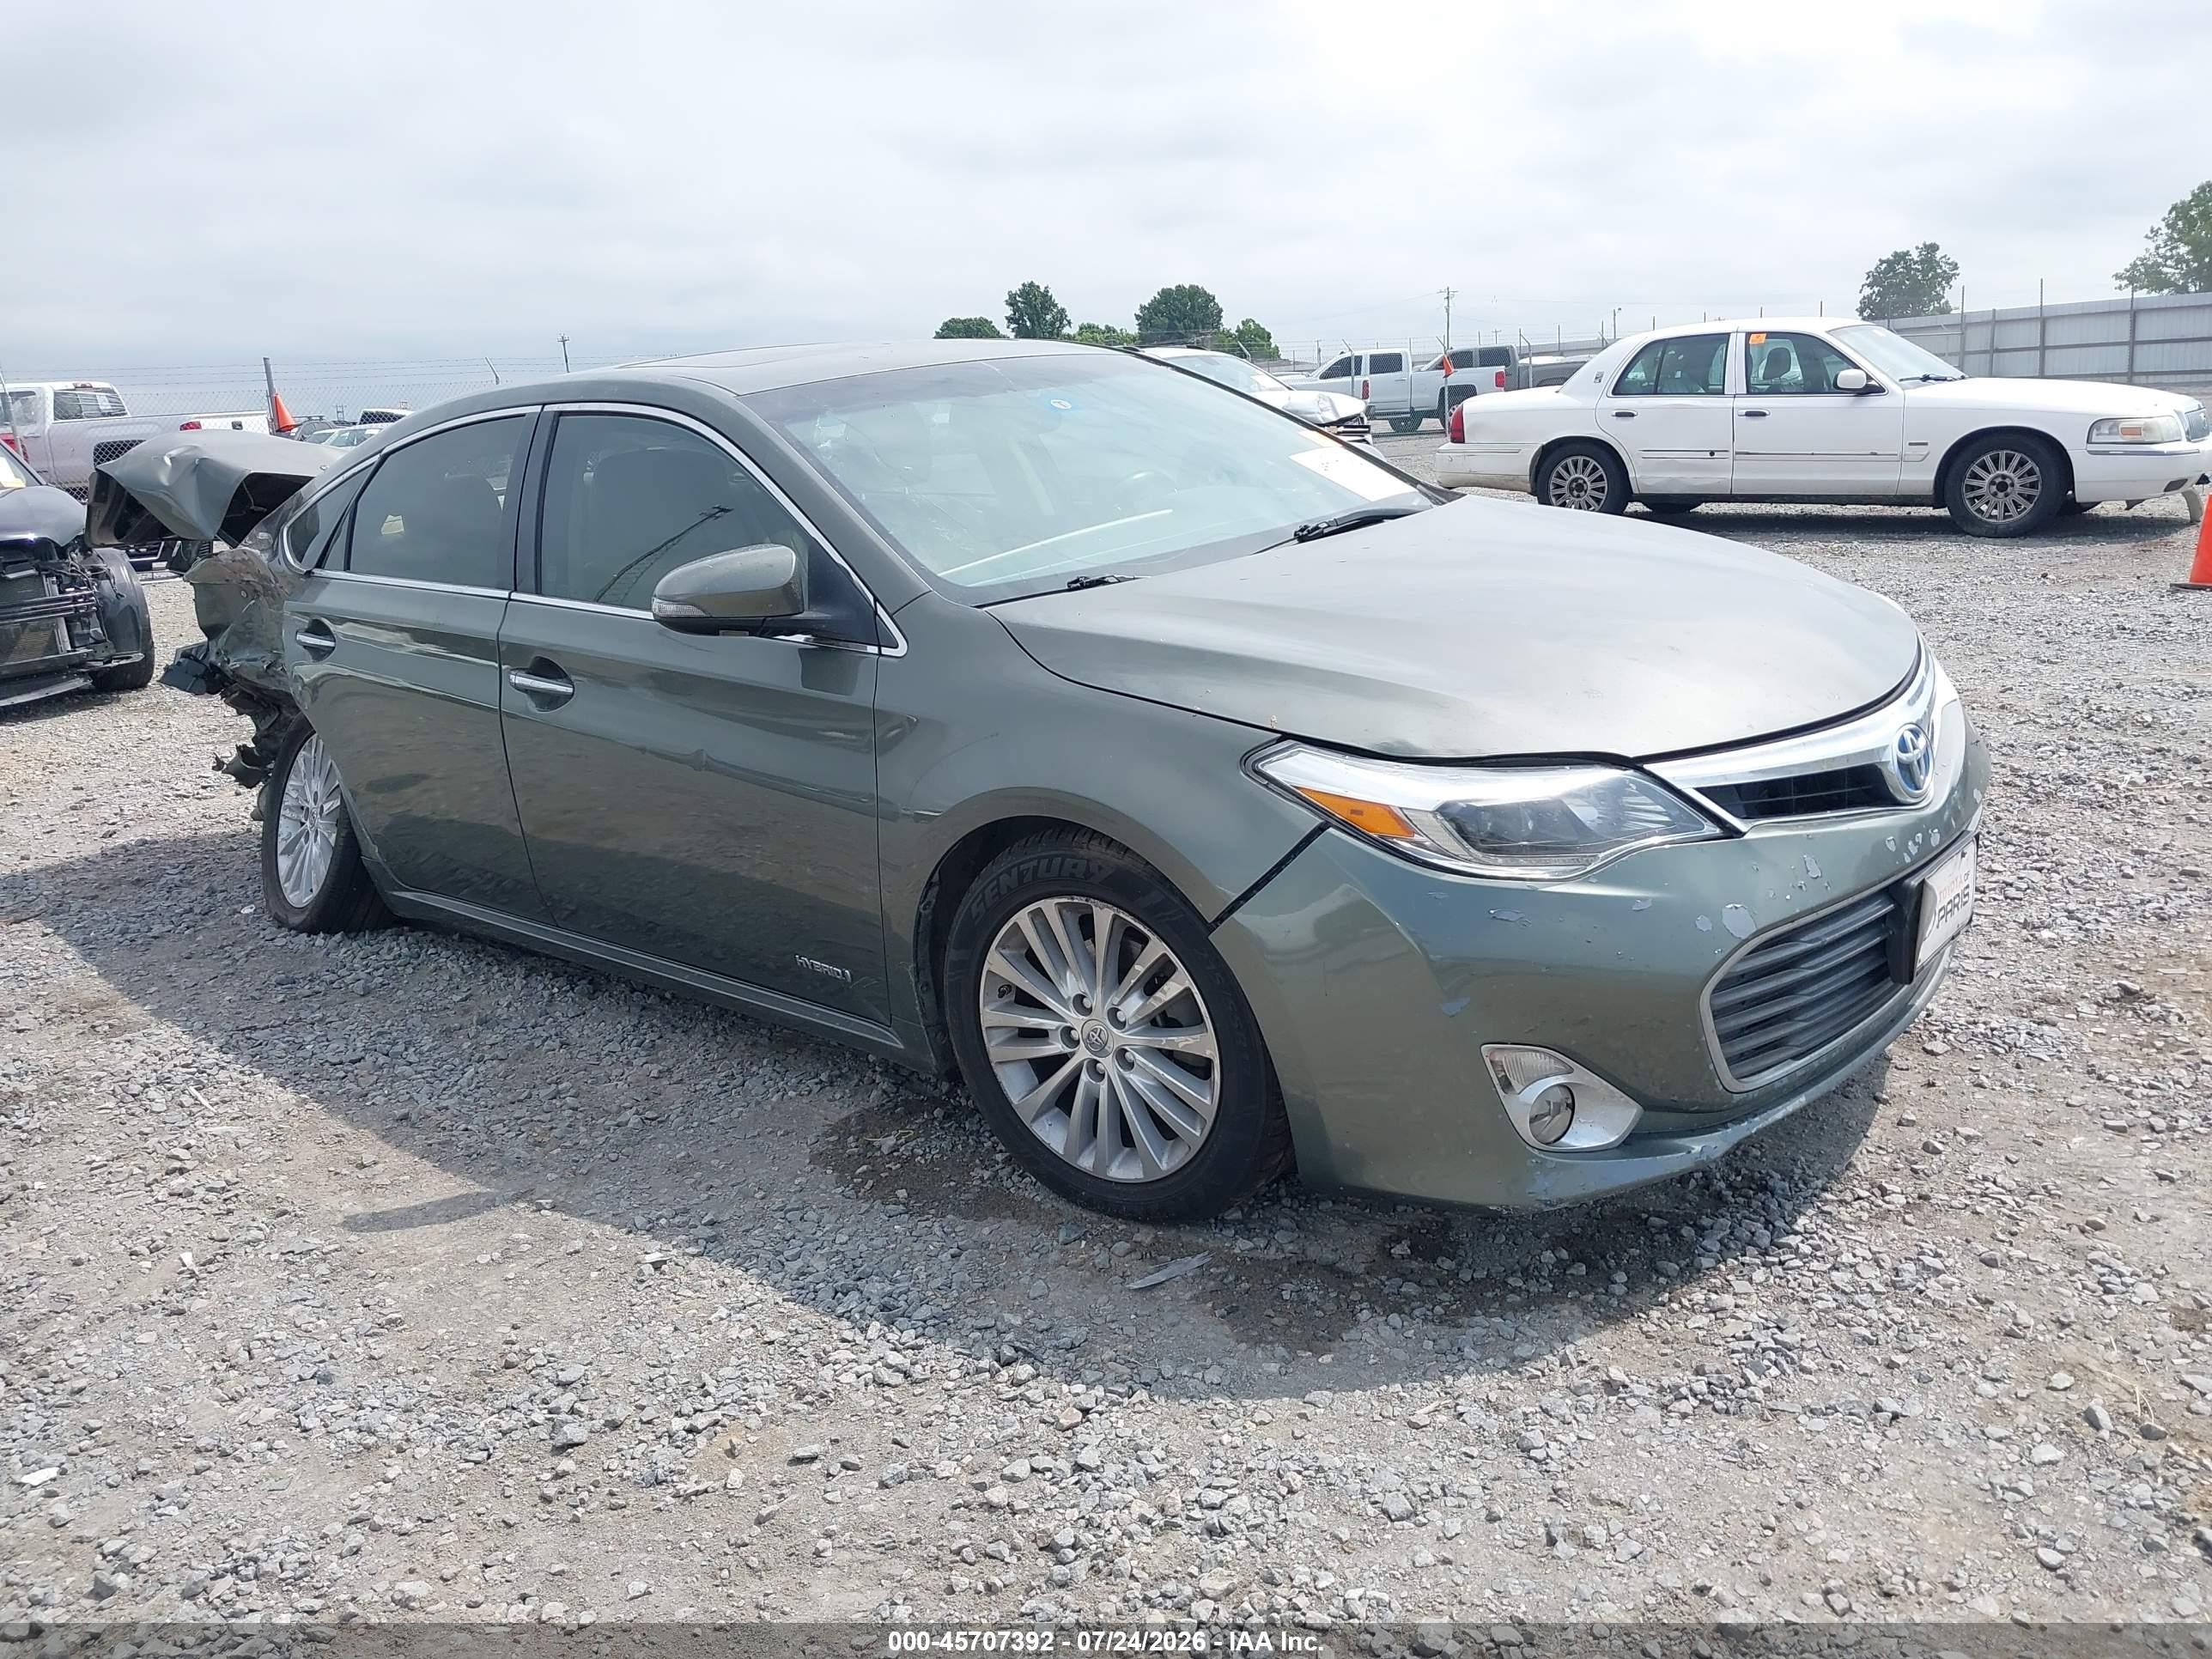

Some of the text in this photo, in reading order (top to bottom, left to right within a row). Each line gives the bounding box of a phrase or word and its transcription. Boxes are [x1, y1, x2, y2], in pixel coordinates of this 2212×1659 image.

[971, 857, 1115, 924] SENTURY
[1963, 871, 1970, 882] OF
[1936, 884, 1970, 929] PARIS
[794, 954, 845, 981] HYBRID
